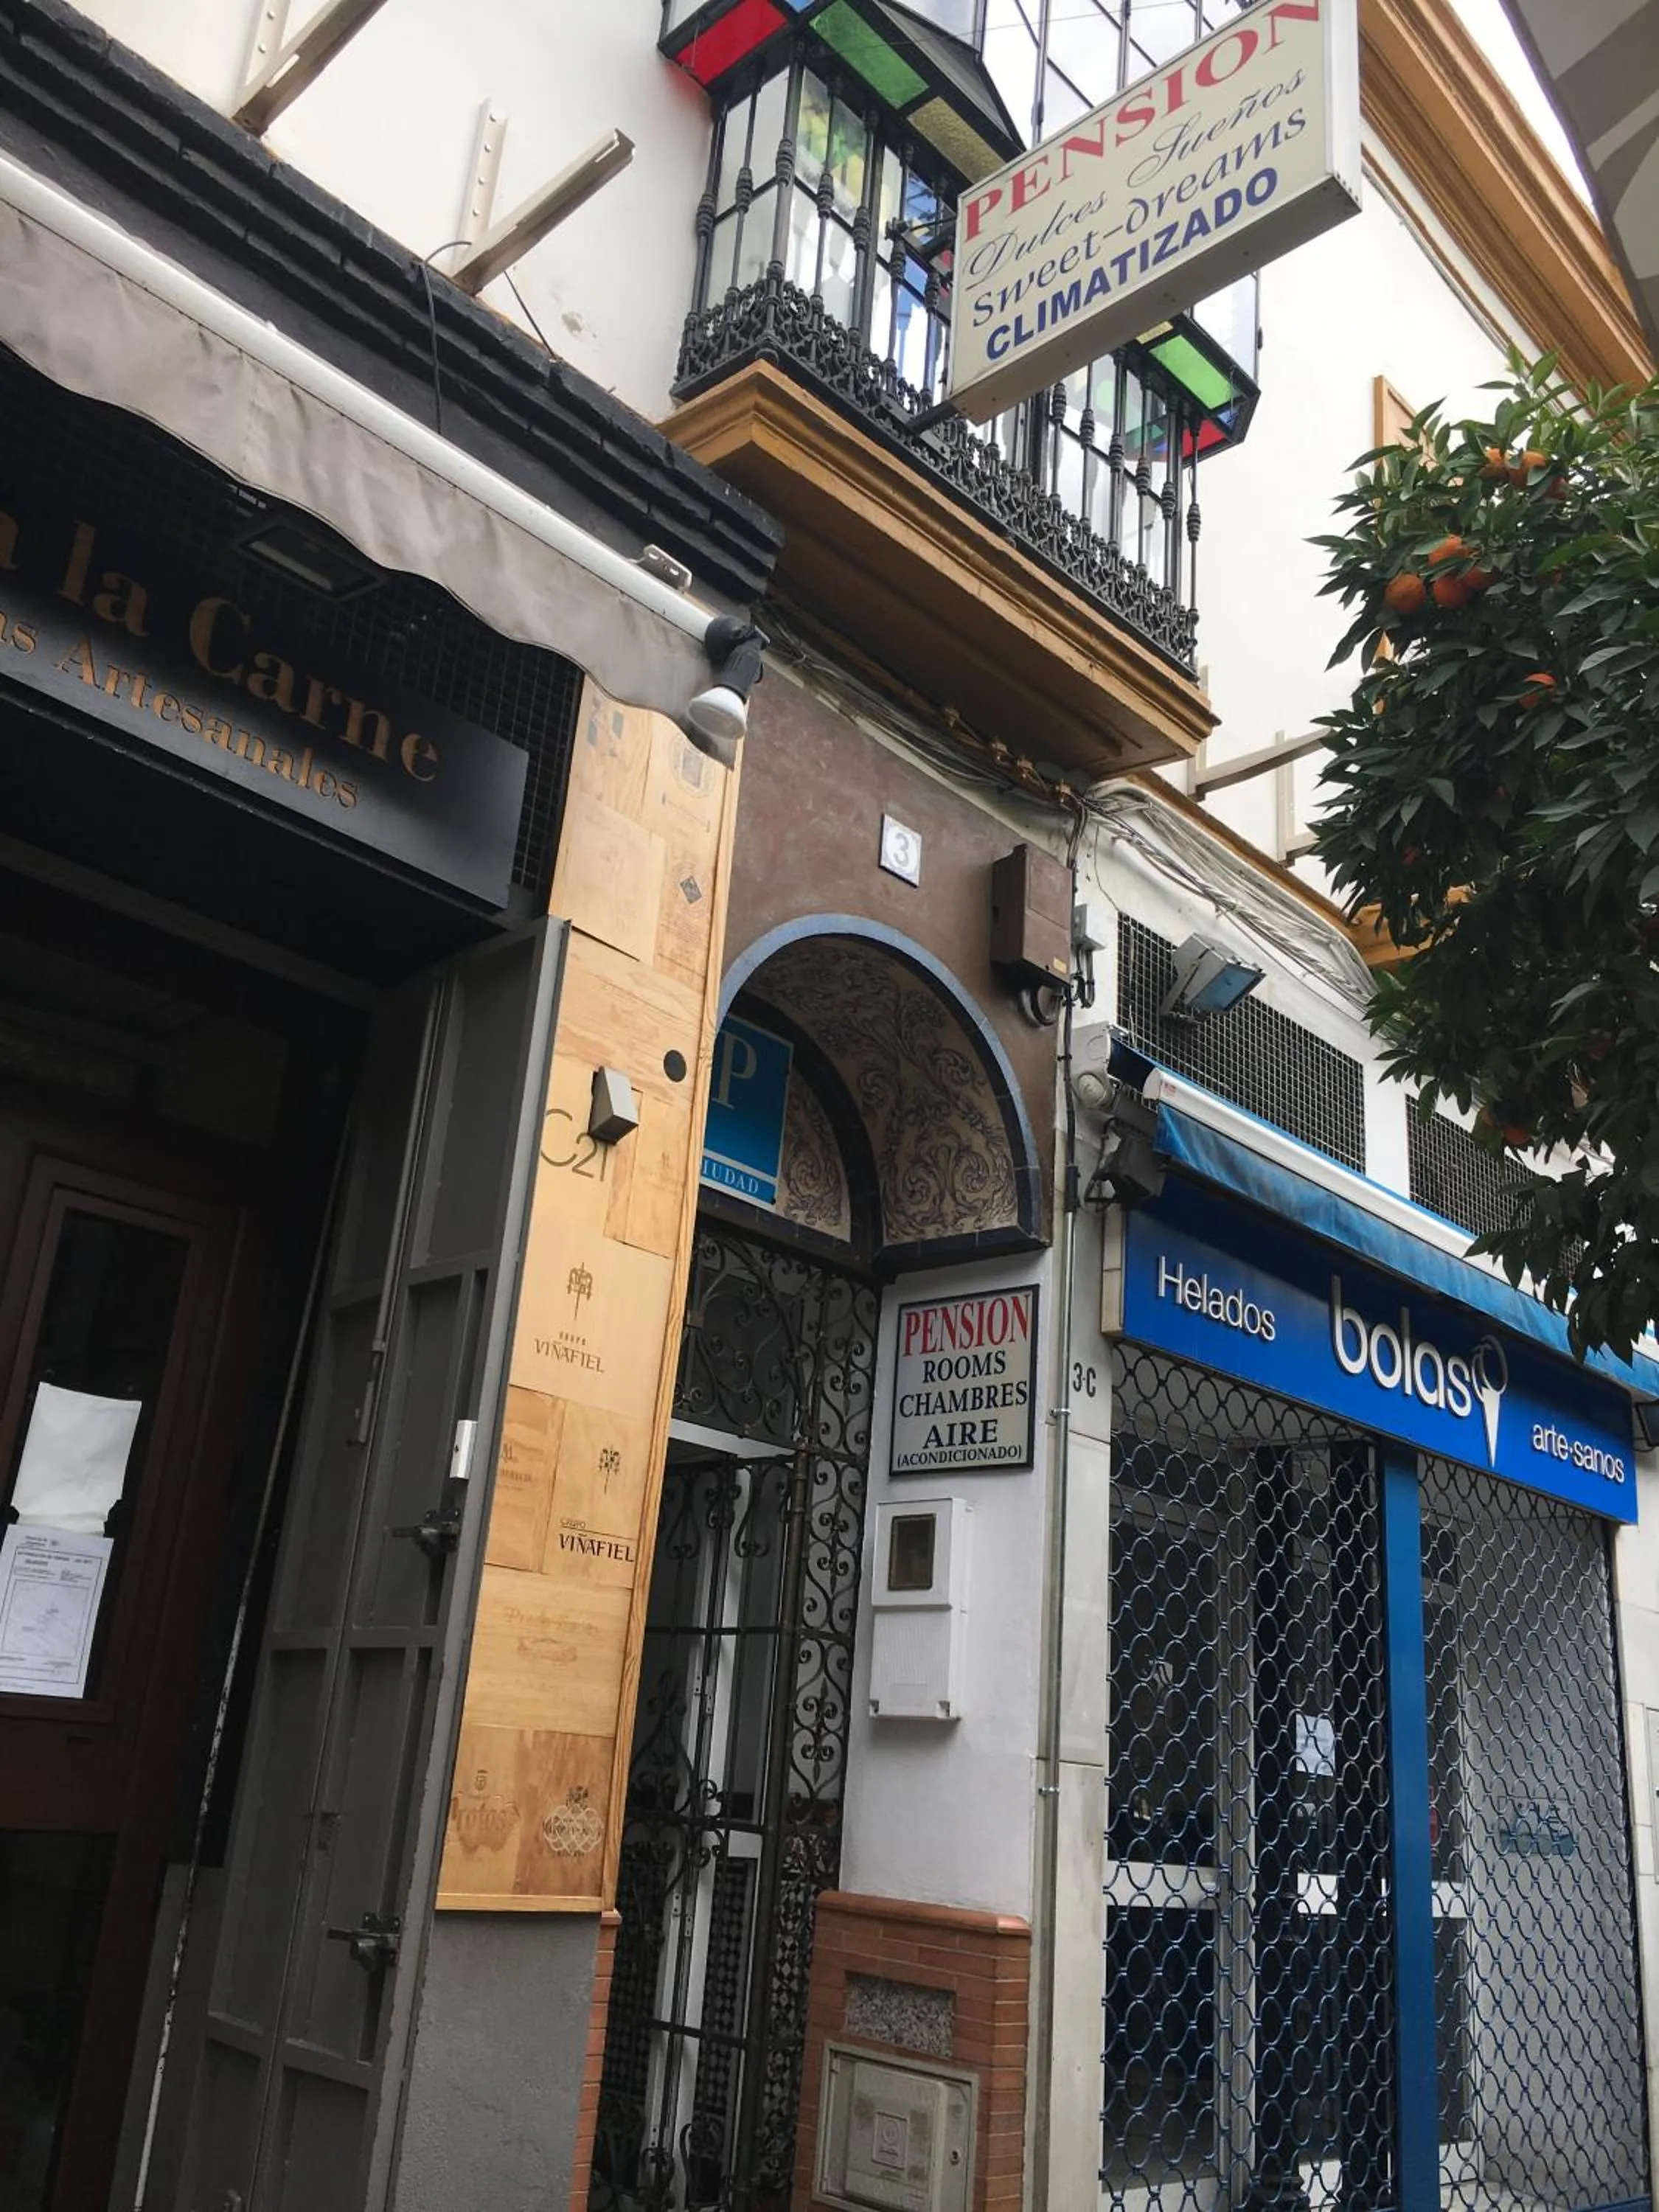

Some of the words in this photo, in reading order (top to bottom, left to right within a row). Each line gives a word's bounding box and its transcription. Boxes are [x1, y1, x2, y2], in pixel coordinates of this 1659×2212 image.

[964, 0, 1319, 242] PENSION
[962, 191, 1107, 292] Dulces
[1126, 66, 1307, 188] Sueños
[985, 167, 1278, 362] CLIMATIZADO
[58, 518, 149, 638] la
[189, 597, 438, 783] Carne
[52, 634, 360, 812] Artesanales
[894, 832, 910, 868] 3
[711, 1029, 758, 1110] P
[702, 1160, 759, 1194] IUDAD
[902, 1294, 1031, 1357] PENSION
[1156, 1255, 1276, 1342] Helados
[534, 1338, 605, 1374] VIÑAFIEL
[922, 1350, 1006, 1384] ROOMS
[1332, 1274, 1473, 1418] bolas
[899, 1380, 1028, 1419] CHAMBRES
[897, 1444, 1022, 1468] (ACONDICIONADO)
[922, 1419, 998, 1449] AIRE
[559, 1533, 635, 1562] VIÑAFIEL
